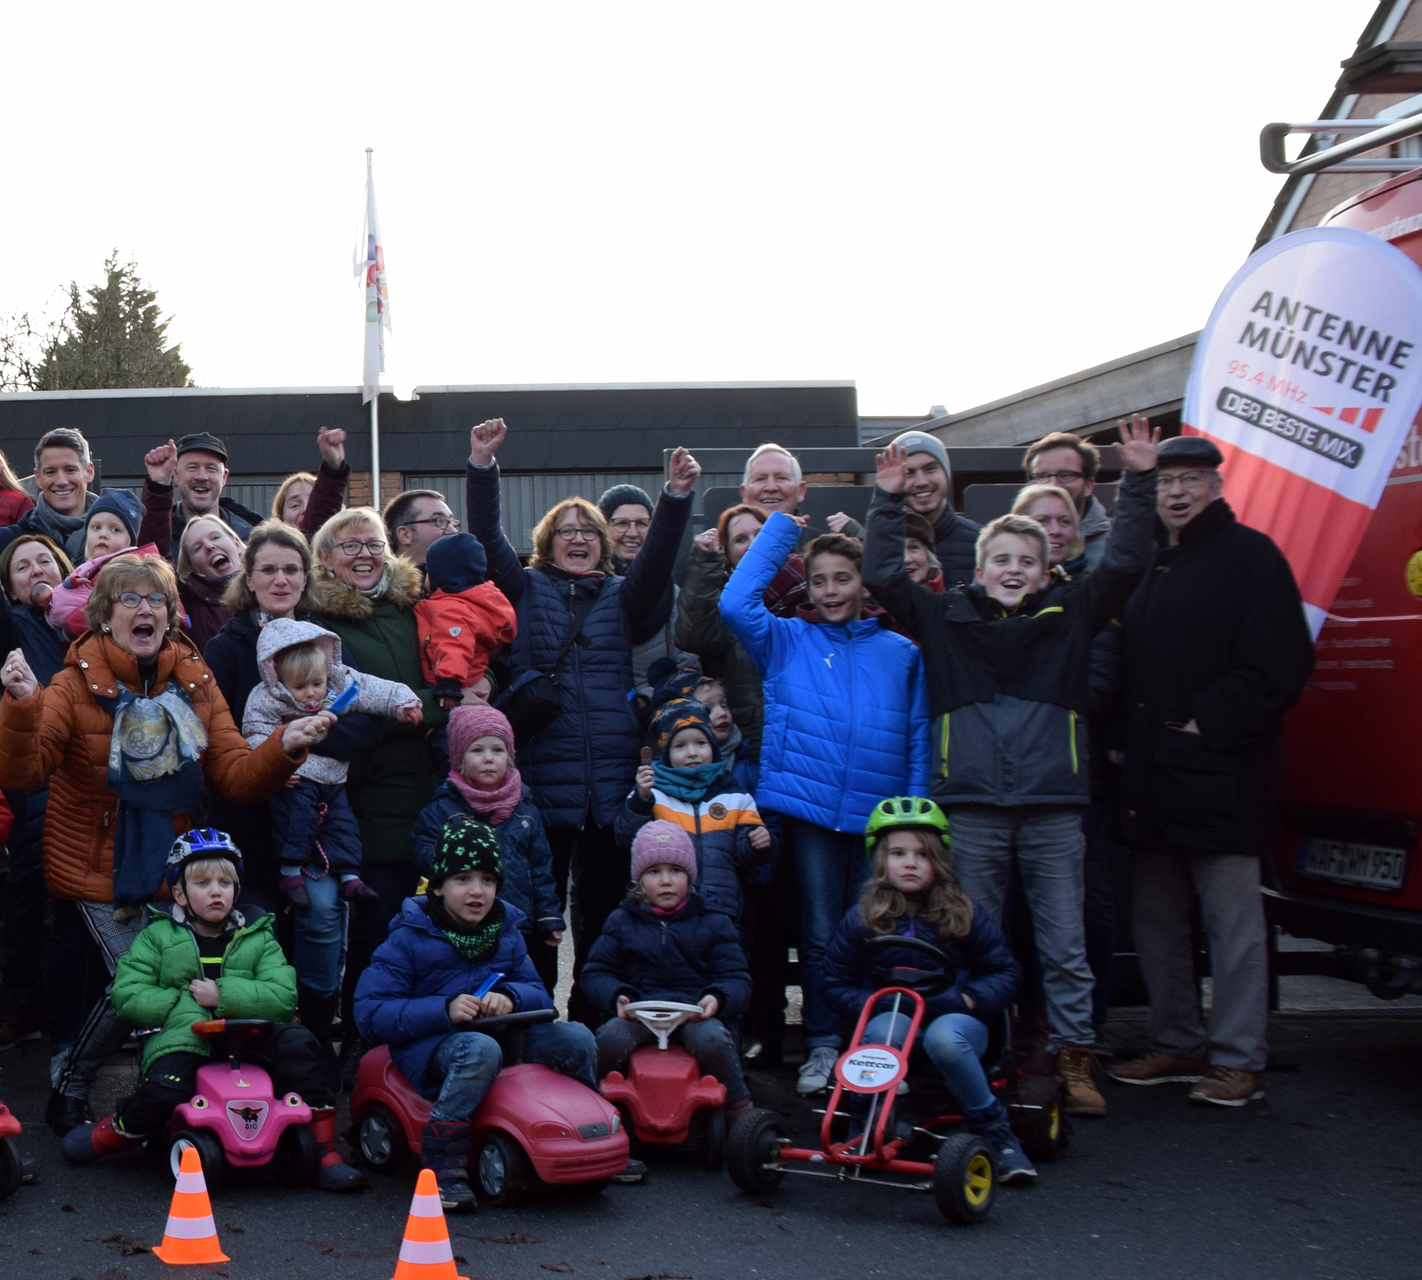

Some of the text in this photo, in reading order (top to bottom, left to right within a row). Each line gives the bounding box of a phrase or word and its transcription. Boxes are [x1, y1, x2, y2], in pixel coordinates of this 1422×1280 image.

[1251, 290, 1415, 371] ANTENNE
[1226, 359, 1310, 405] 95.4 MHz
[1238, 321, 1398, 403] MÜNSTER
[1223, 392, 1262, 421] DER
[1260, 408, 1320, 446] BESTE
[1371, 850, 1405, 881] 950
[848, 1058, 897, 1070] Kettcar
